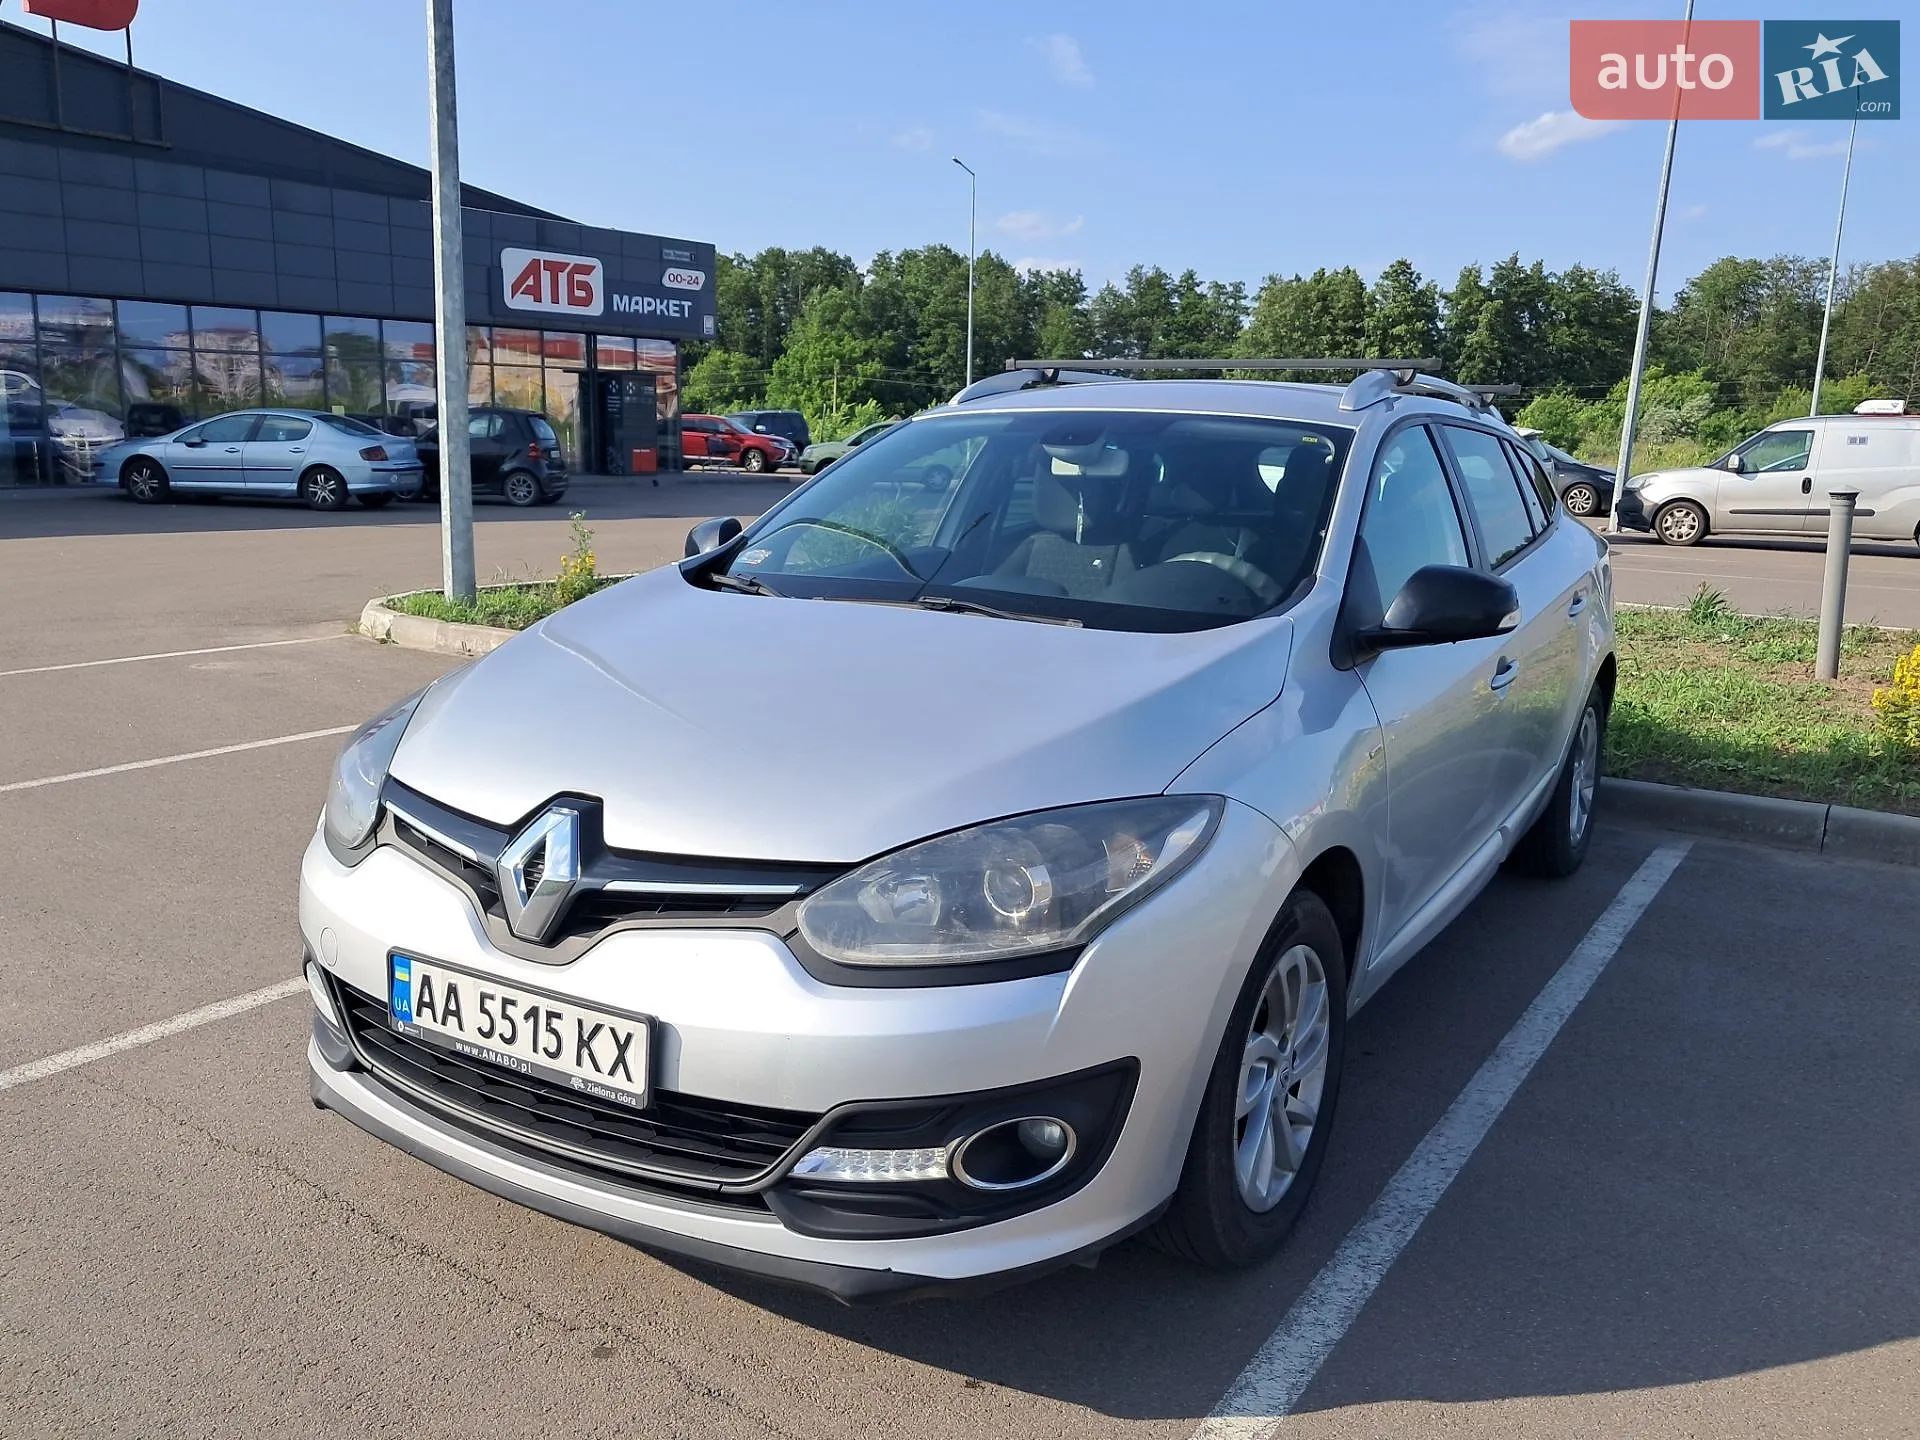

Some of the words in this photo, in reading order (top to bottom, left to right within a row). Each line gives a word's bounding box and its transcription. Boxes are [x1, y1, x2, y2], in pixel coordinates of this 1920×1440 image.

[511, 258, 597, 308] АТБ
[668, 272, 700, 286] 00-24
[612, 293, 693, 318] МАРКЕТ
[394, 996, 410, 1013] UA
[415, 973, 466, 1033] AA
[476, 990, 564, 1060] 5515
[575, 1017, 635, 1083] KX
[455, 1040, 533, 1074] www.ANABO.pl
[587, 1082, 616, 1099] Zielona
[617, 1092, 637, 1106] Góra
